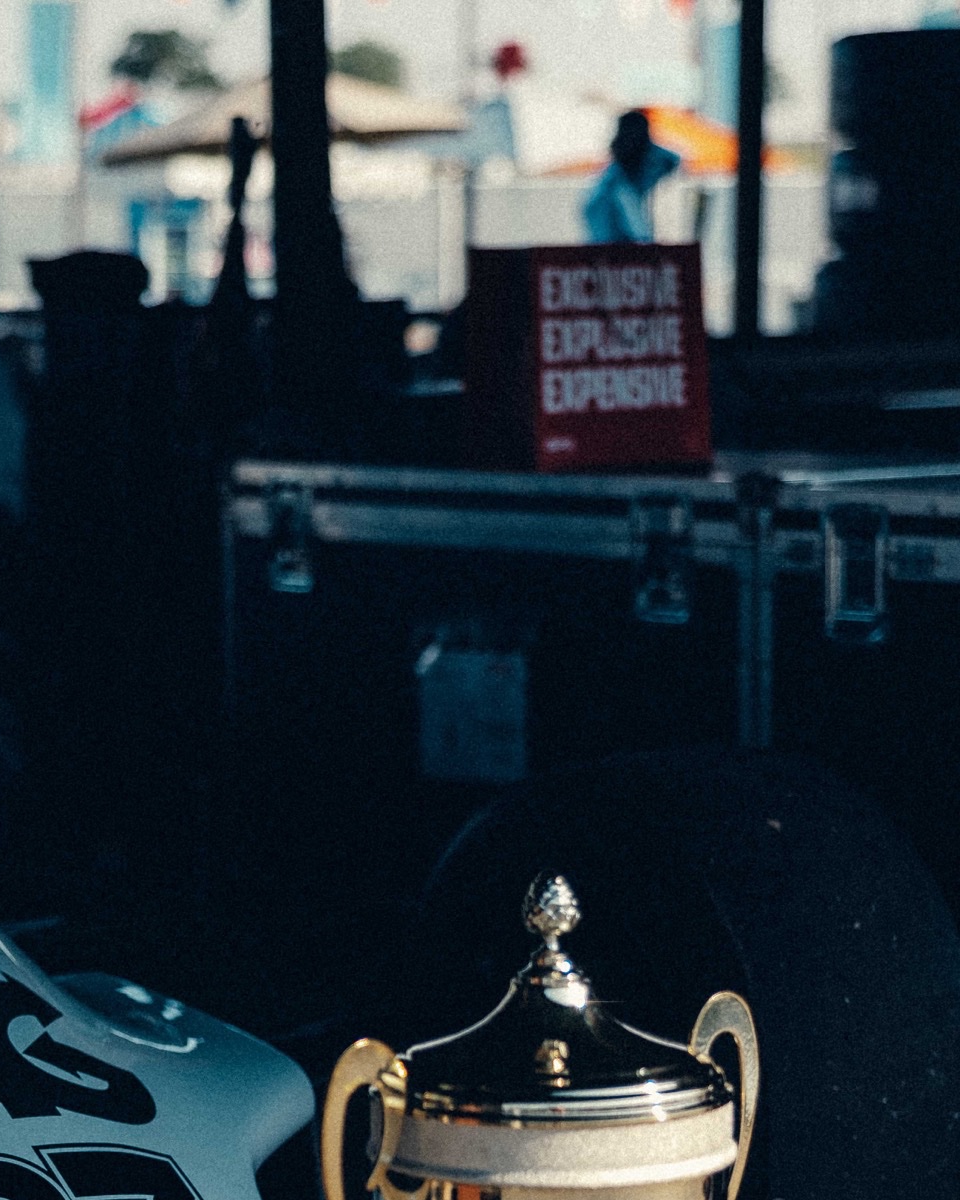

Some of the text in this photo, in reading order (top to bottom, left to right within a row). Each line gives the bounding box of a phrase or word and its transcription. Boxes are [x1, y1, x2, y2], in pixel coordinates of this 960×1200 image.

[542, 264, 679, 310] EXCLUSIVE
[542, 314, 682, 362] EXPLOSIVE
[543, 364, 685, 413] EXPENSIVE
